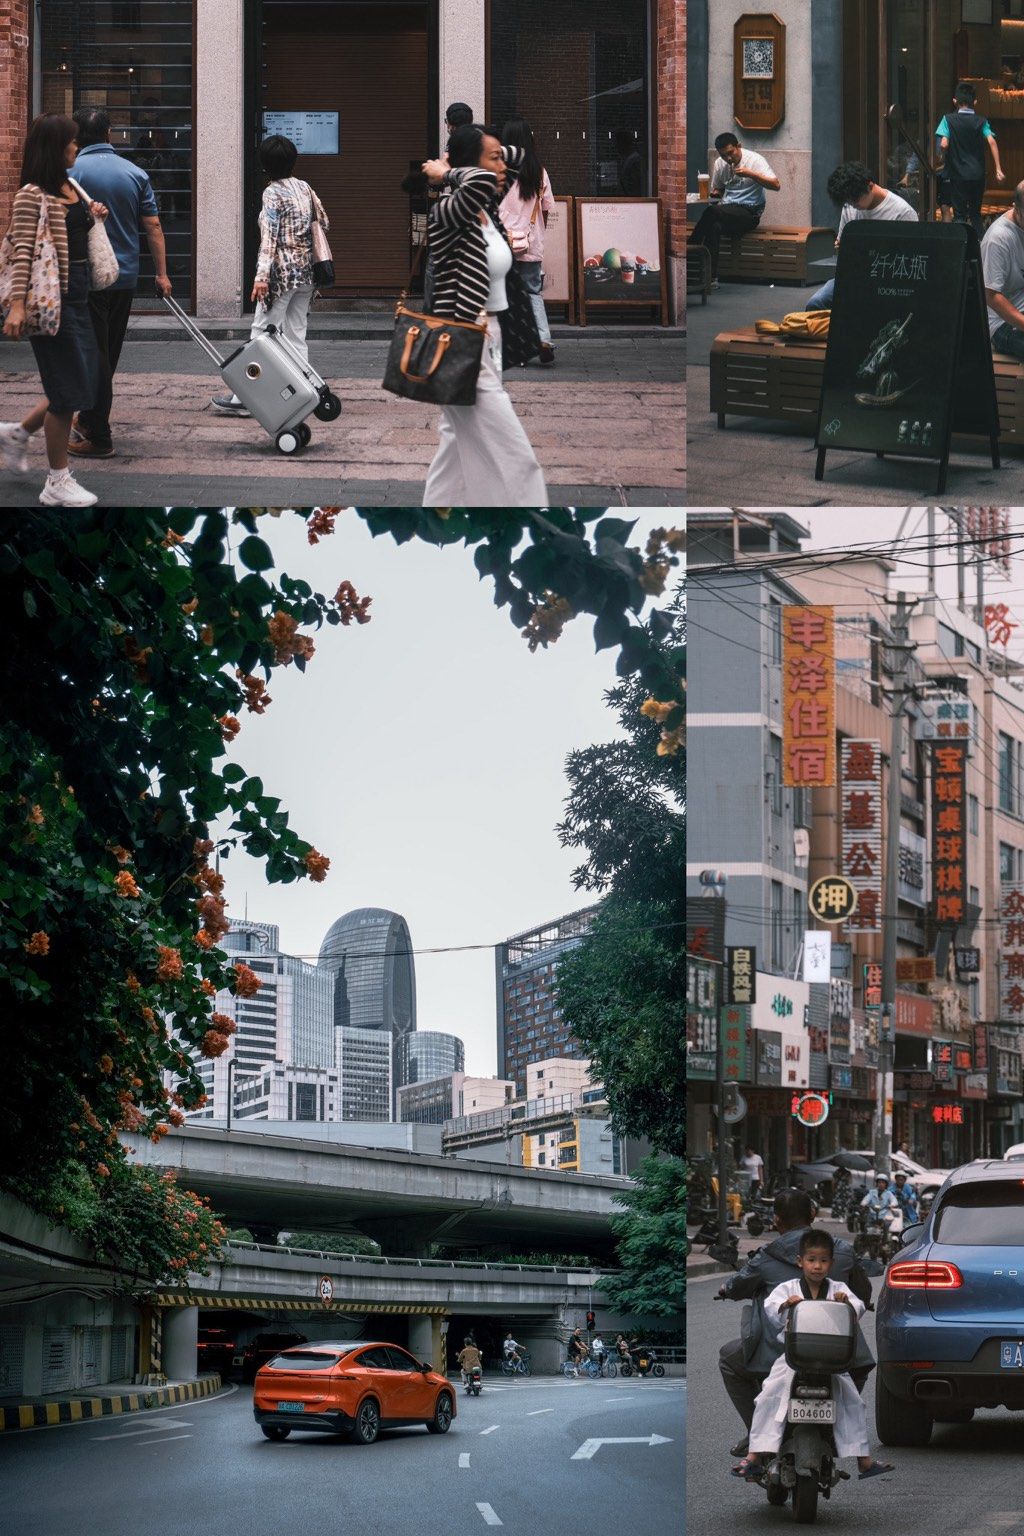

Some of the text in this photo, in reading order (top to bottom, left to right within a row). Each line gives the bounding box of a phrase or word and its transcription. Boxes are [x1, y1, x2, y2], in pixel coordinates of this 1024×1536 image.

[788, 610, 829, 783] 丰泽住宿
[935, 747, 963, 922] 宝顿桌球棋牌
[817, 883, 849, 914] 押
[802, 1099, 823, 1121] 押
[932, 1105, 963, 1124] 便利店
